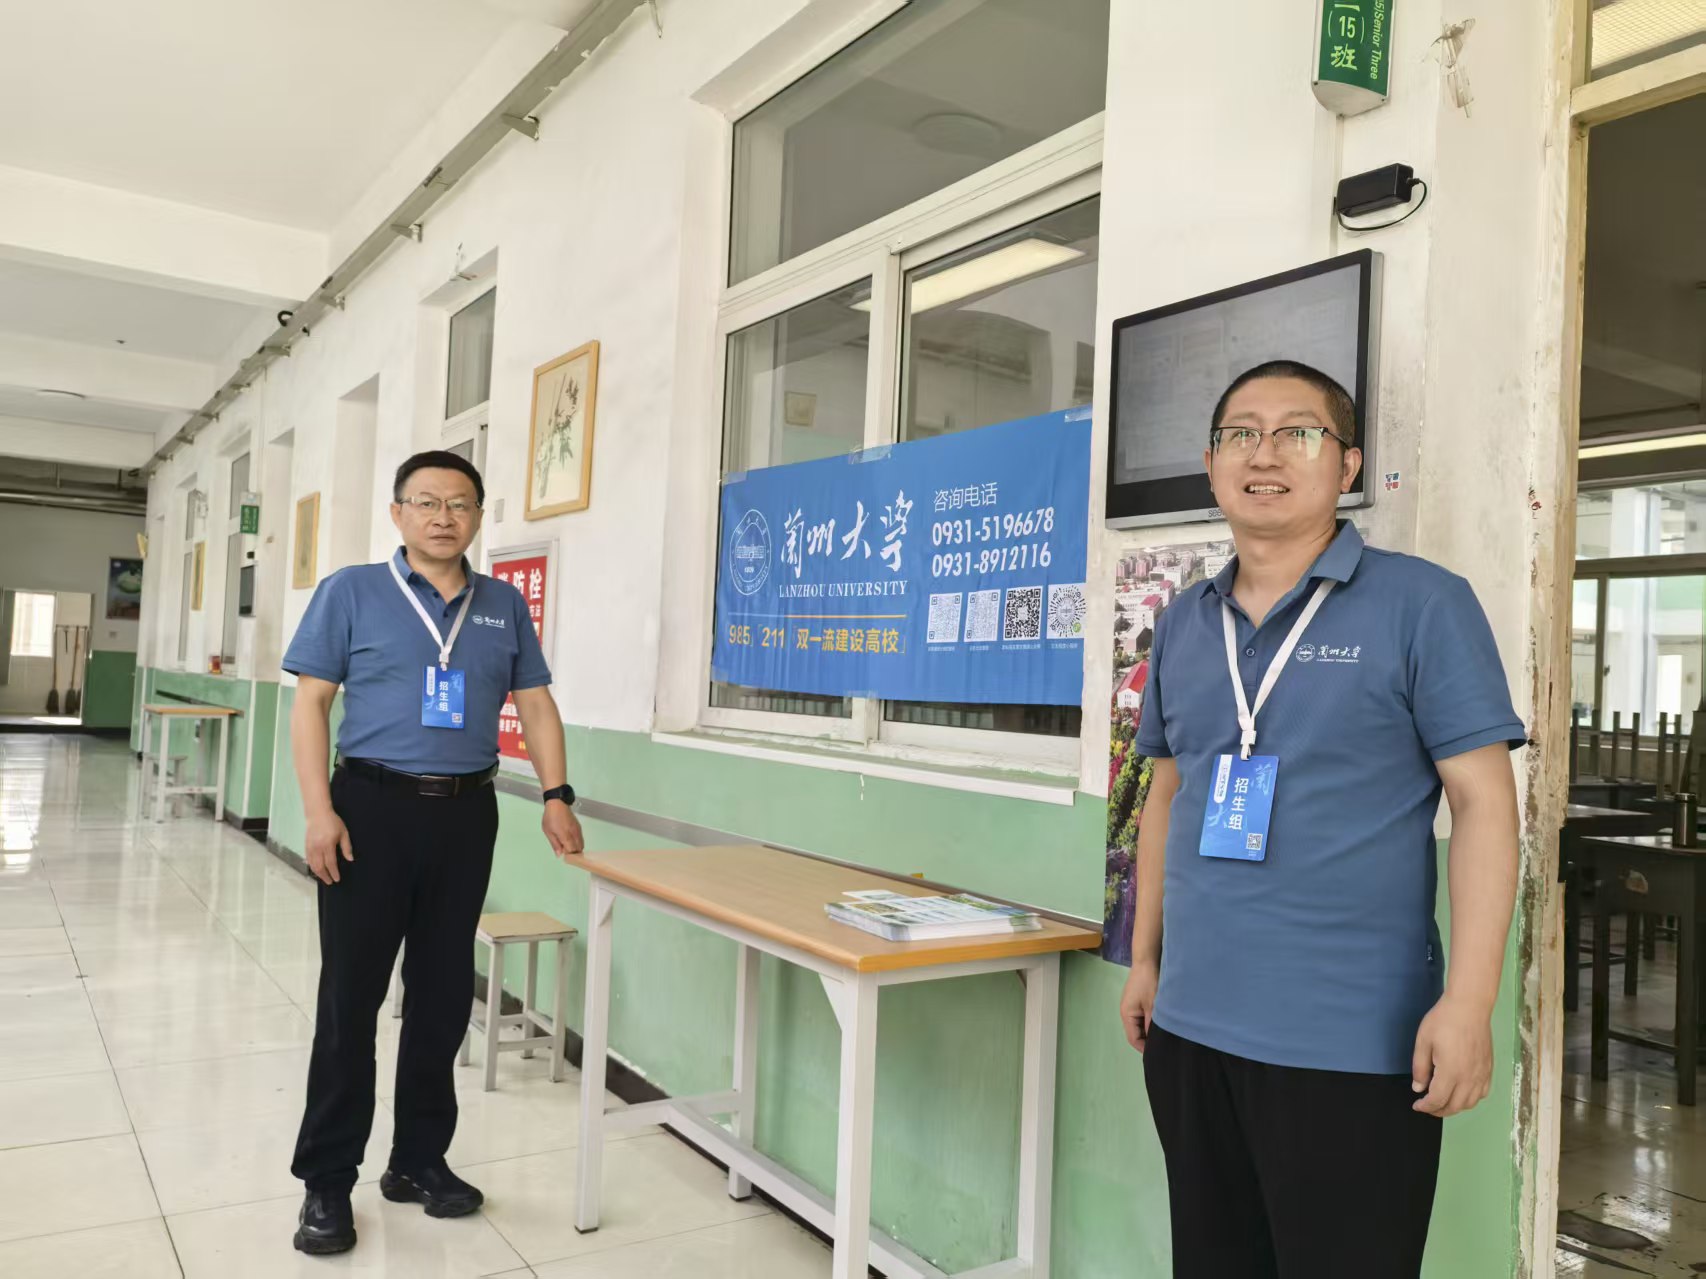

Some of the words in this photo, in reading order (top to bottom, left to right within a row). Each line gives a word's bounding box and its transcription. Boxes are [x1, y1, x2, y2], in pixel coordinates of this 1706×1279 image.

[1369, 50, 1382, 79] Three
[933, 482, 998, 512] 咨询电话
[932, 506, 1054, 546] 0931-5196678
[931, 542, 1051, 577] 0931-8912116
[779, 584, 828, 598] LANZHOU
[829, 580, 908, 597] UNIVERSITY
[439, 681, 449, 712] 招生组
[1228, 777, 1249, 830] 招生组
